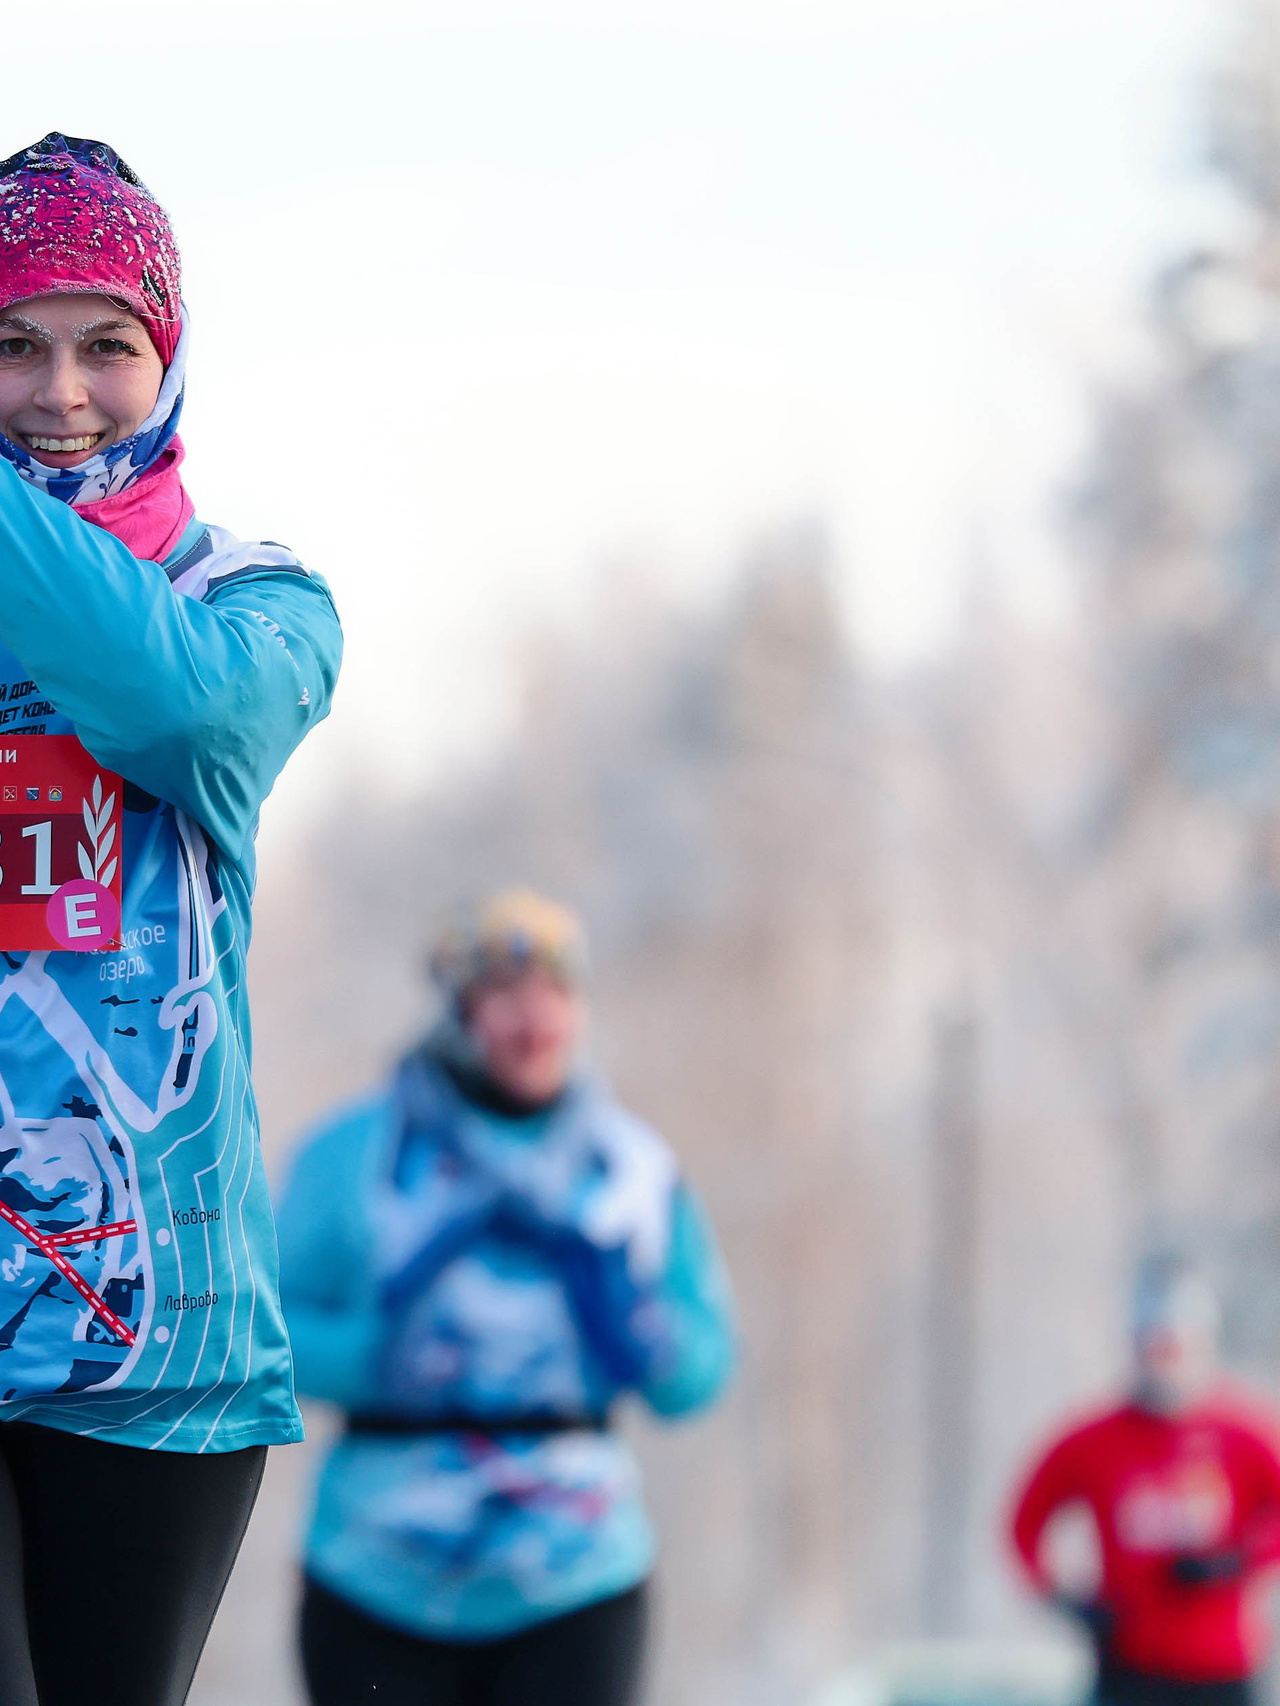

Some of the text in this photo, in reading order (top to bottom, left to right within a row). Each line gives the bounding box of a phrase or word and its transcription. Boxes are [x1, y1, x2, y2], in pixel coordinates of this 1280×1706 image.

[99, 955, 146, 985] озеро
[173, 1207, 221, 1228] Кобона
[164, 1290, 219, 1314] Лаврово
